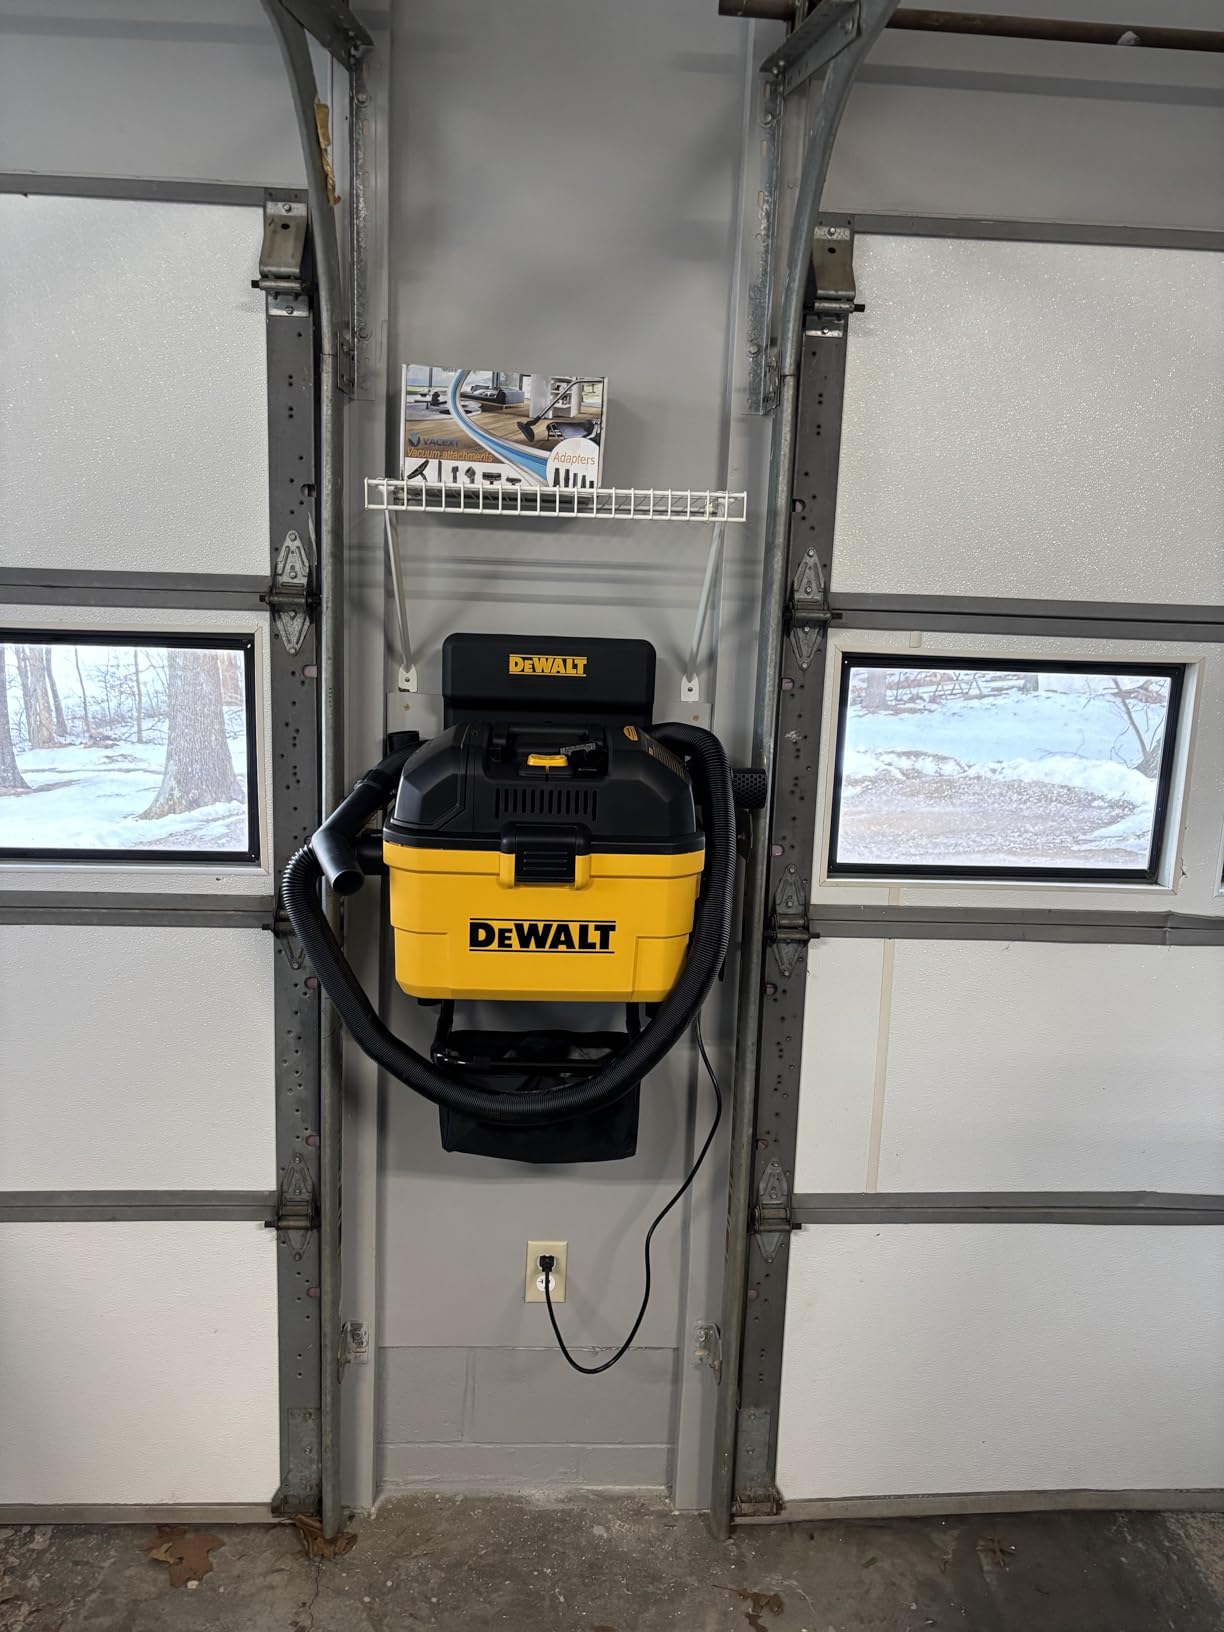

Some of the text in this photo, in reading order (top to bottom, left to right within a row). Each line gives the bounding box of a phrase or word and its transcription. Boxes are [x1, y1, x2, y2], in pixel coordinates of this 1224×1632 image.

[407, 447, 493, 462] Vacuum attachments
[553, 451, 596, 466] Adapters
